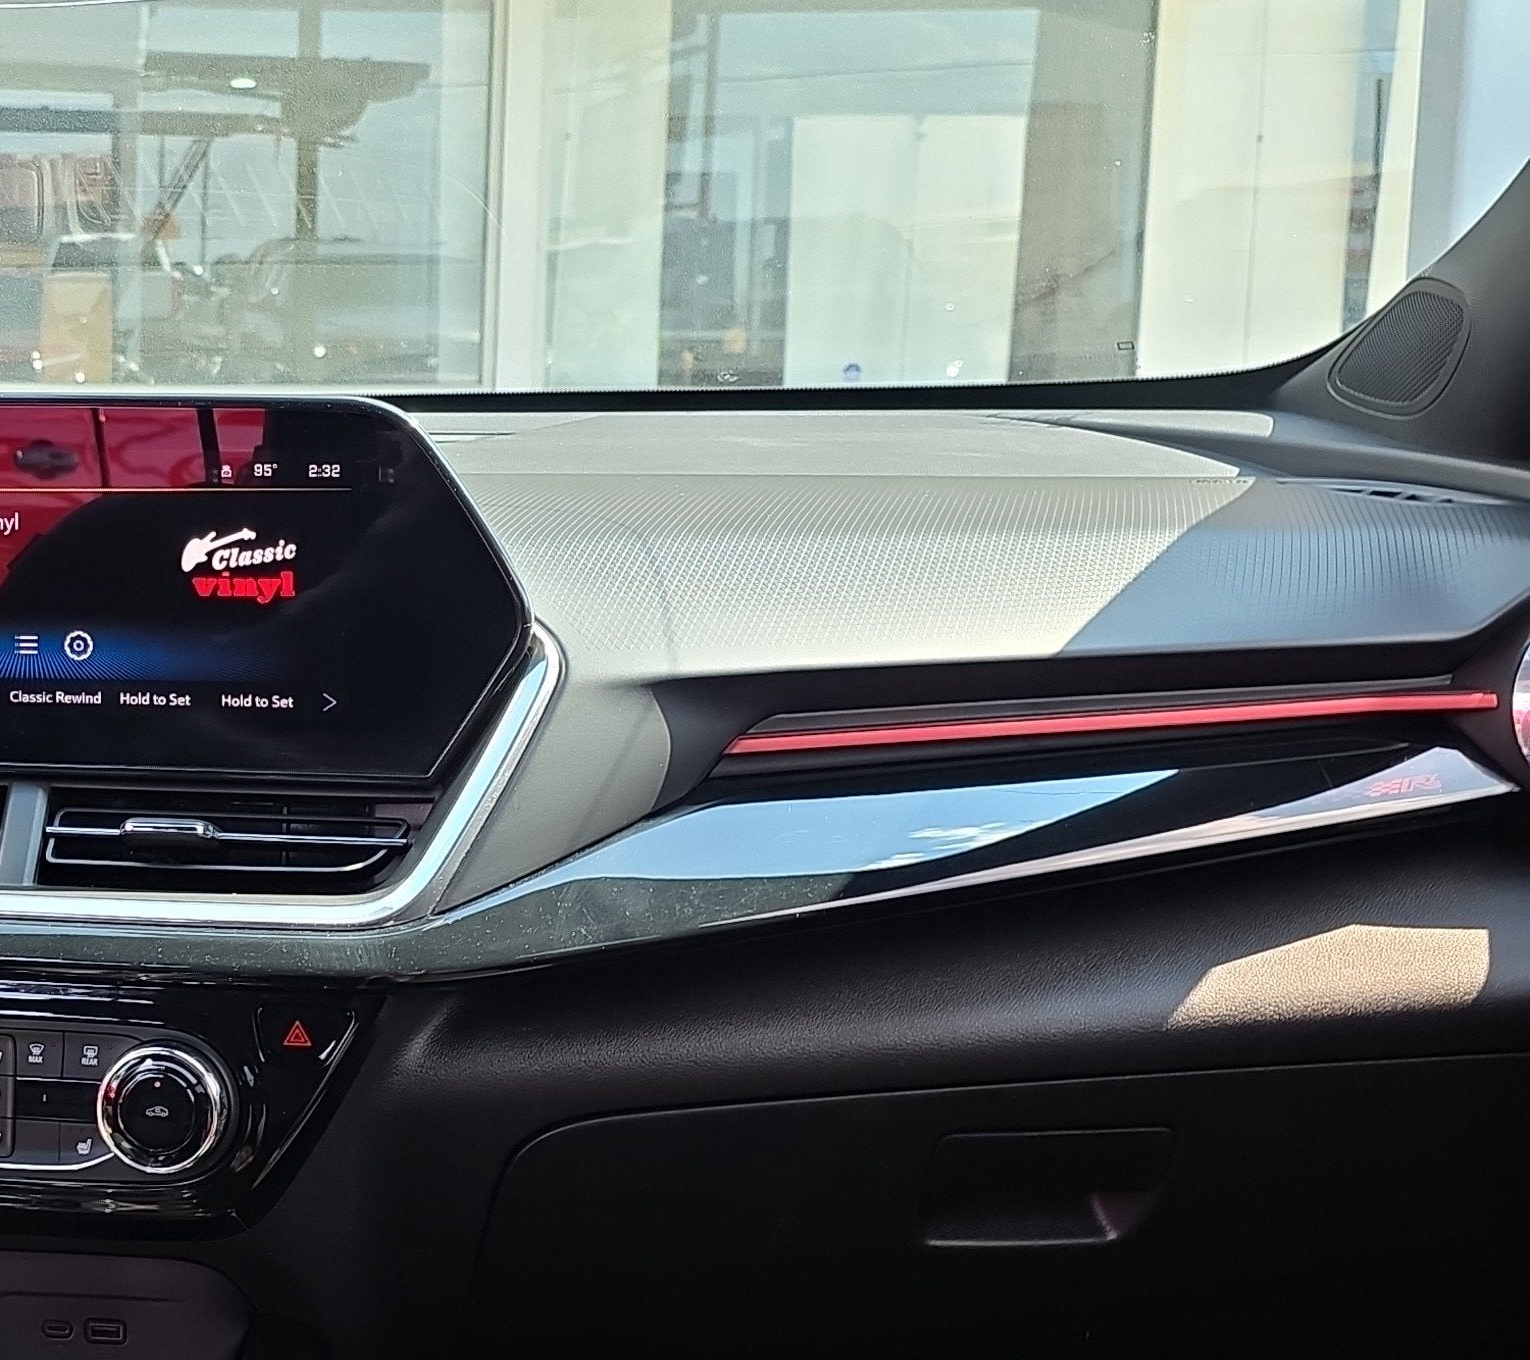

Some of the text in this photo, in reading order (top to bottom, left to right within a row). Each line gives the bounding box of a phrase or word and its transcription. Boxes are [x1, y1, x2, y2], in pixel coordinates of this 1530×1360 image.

[253, 463, 341, 478] 95° 2:32
[211, 539, 297, 571] Classic
[192, 570, 296, 605] vinyl
[9, 690, 102, 706] Classic Rewind
[120, 692, 192, 707] Hold to Set
[221, 694, 294, 709] Hold to Set
